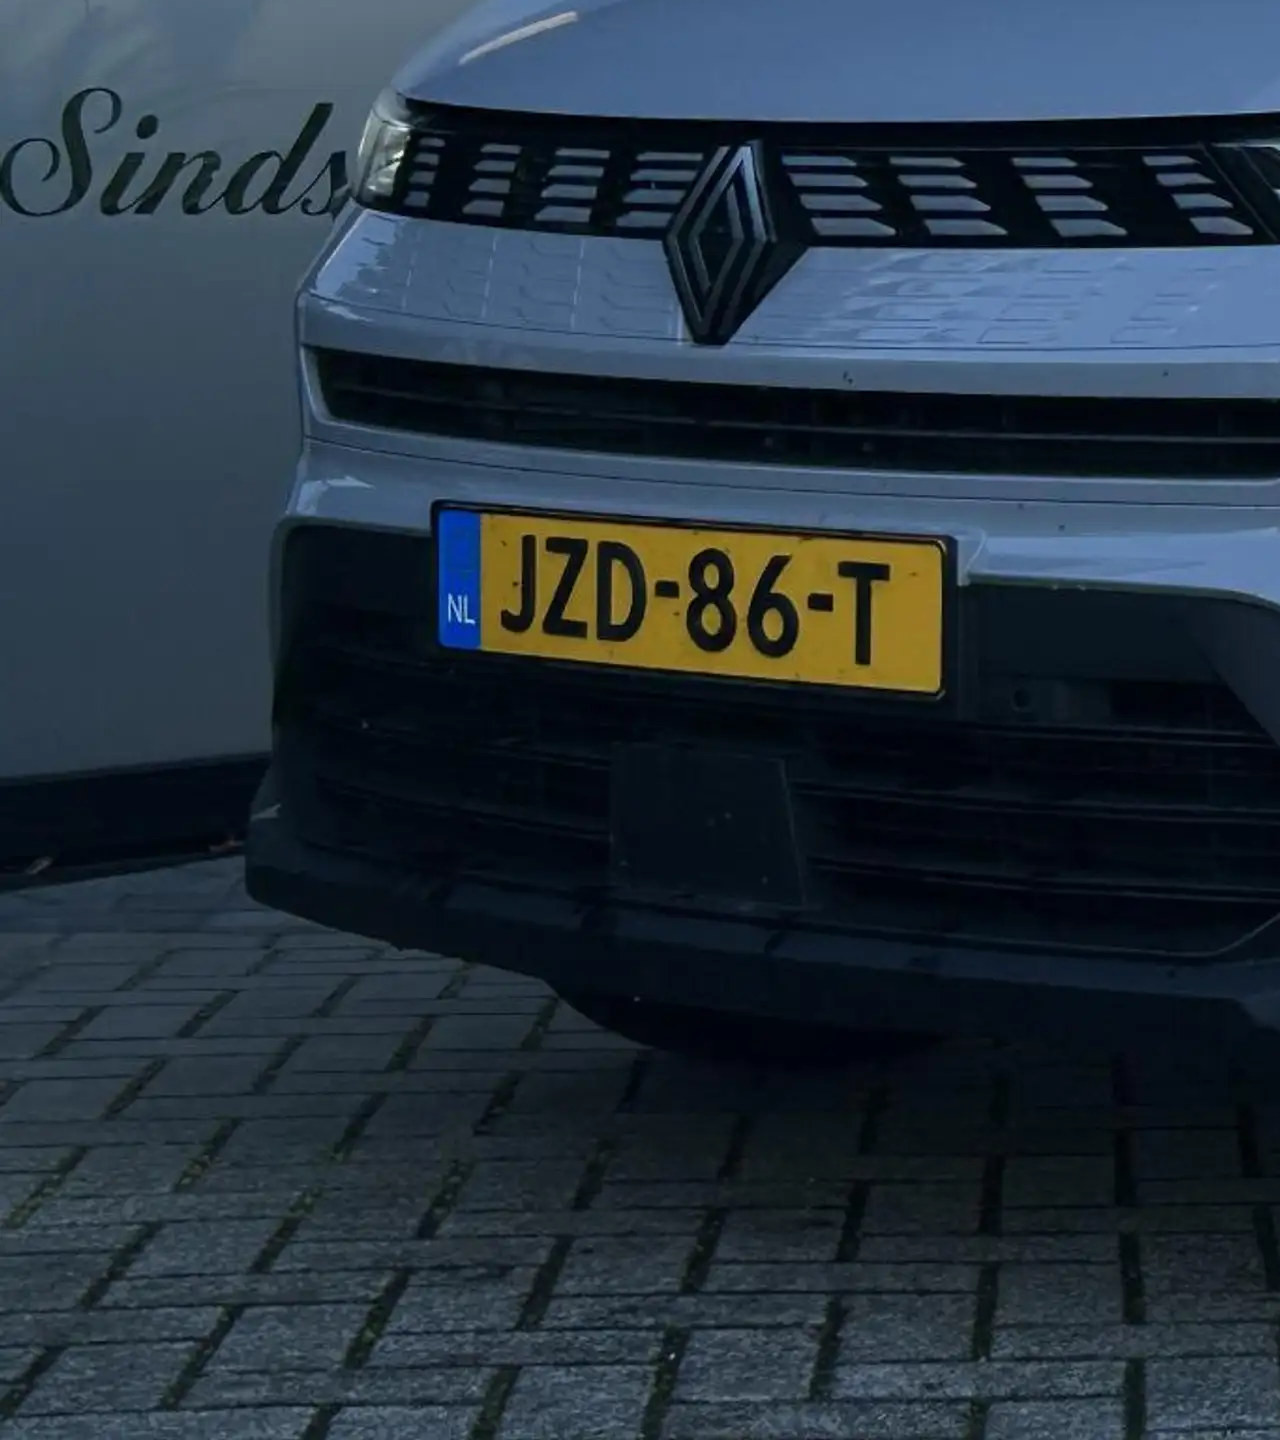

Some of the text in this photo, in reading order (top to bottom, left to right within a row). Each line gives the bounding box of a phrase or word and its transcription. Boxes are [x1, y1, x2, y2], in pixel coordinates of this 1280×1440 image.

[0, 87, 349, 220] Sinds
[447, 592, 476, 626] NL
[500, 533, 891, 666] JZD-86-T
